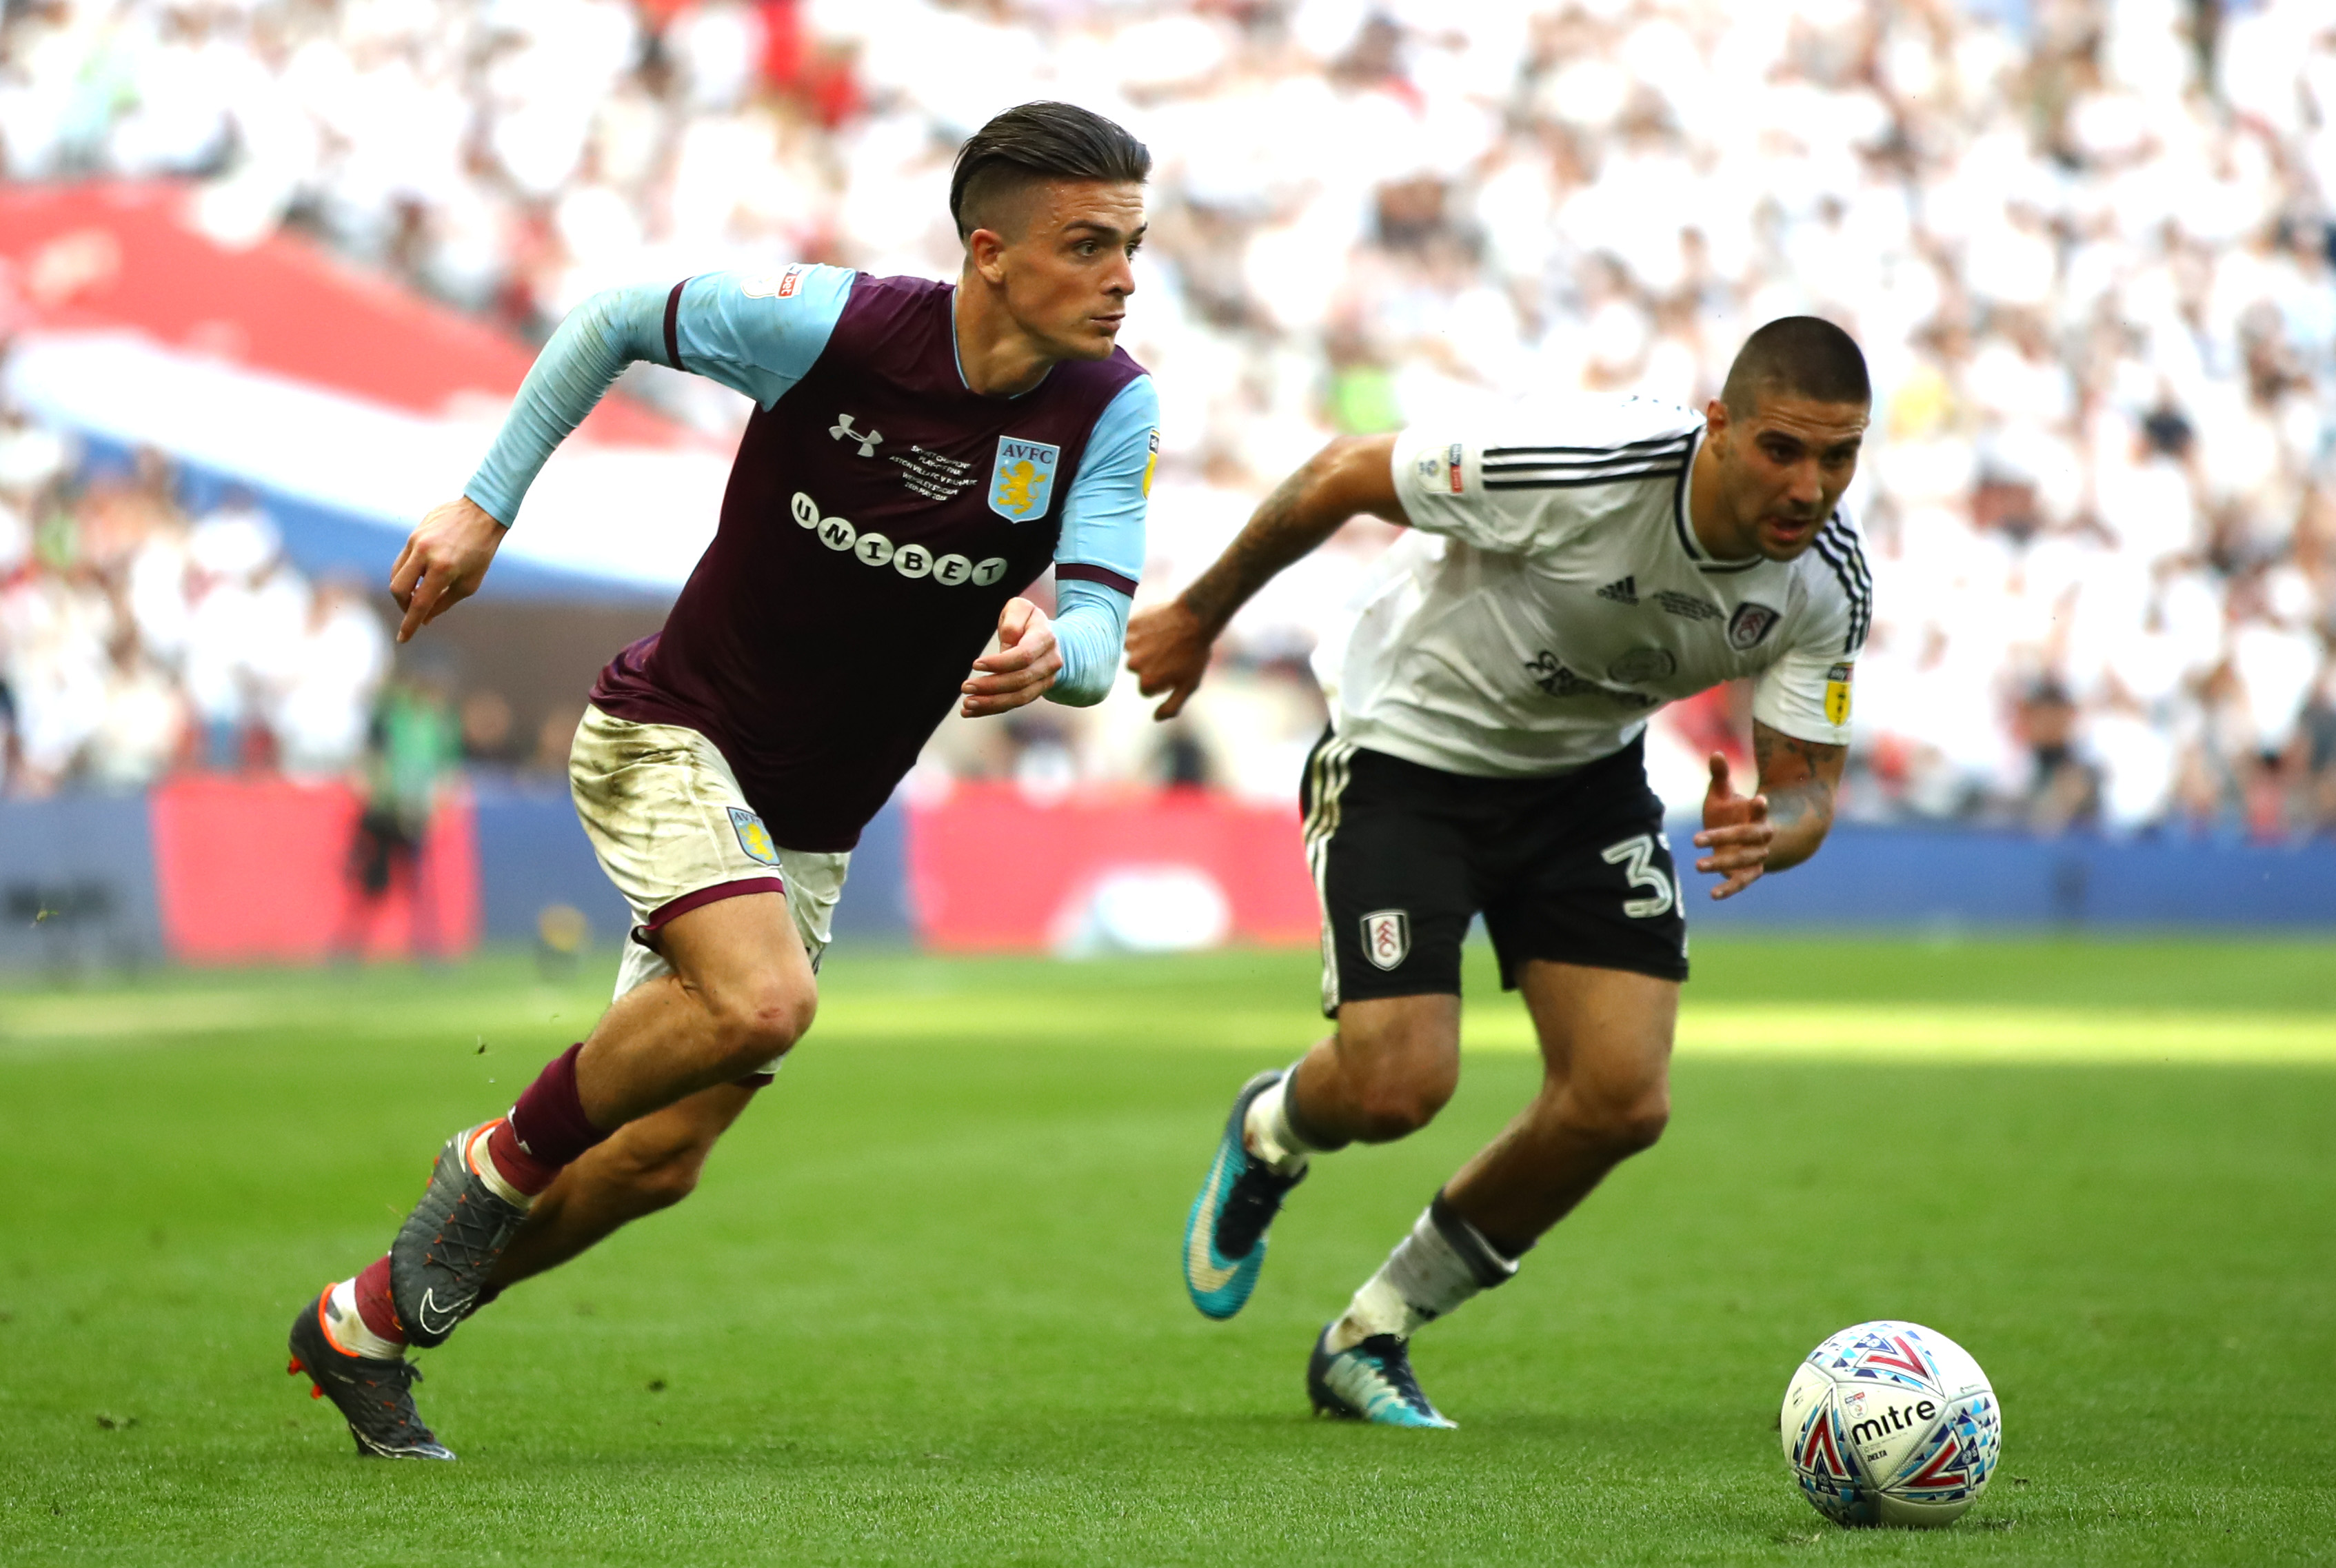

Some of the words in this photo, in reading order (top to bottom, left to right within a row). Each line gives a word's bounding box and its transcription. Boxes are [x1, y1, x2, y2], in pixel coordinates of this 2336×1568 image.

[781, 275, 796, 295] bet
[889, 456, 913, 469] ASTON
[1003, 443, 1053, 465] AVFC
[794, 496, 1002, 581] UNIBET
[1600, 833, 1685, 919] 3
[1851, 1400, 1936, 1445] mitre
[1866, 1449, 1888, 1463] DELTA
